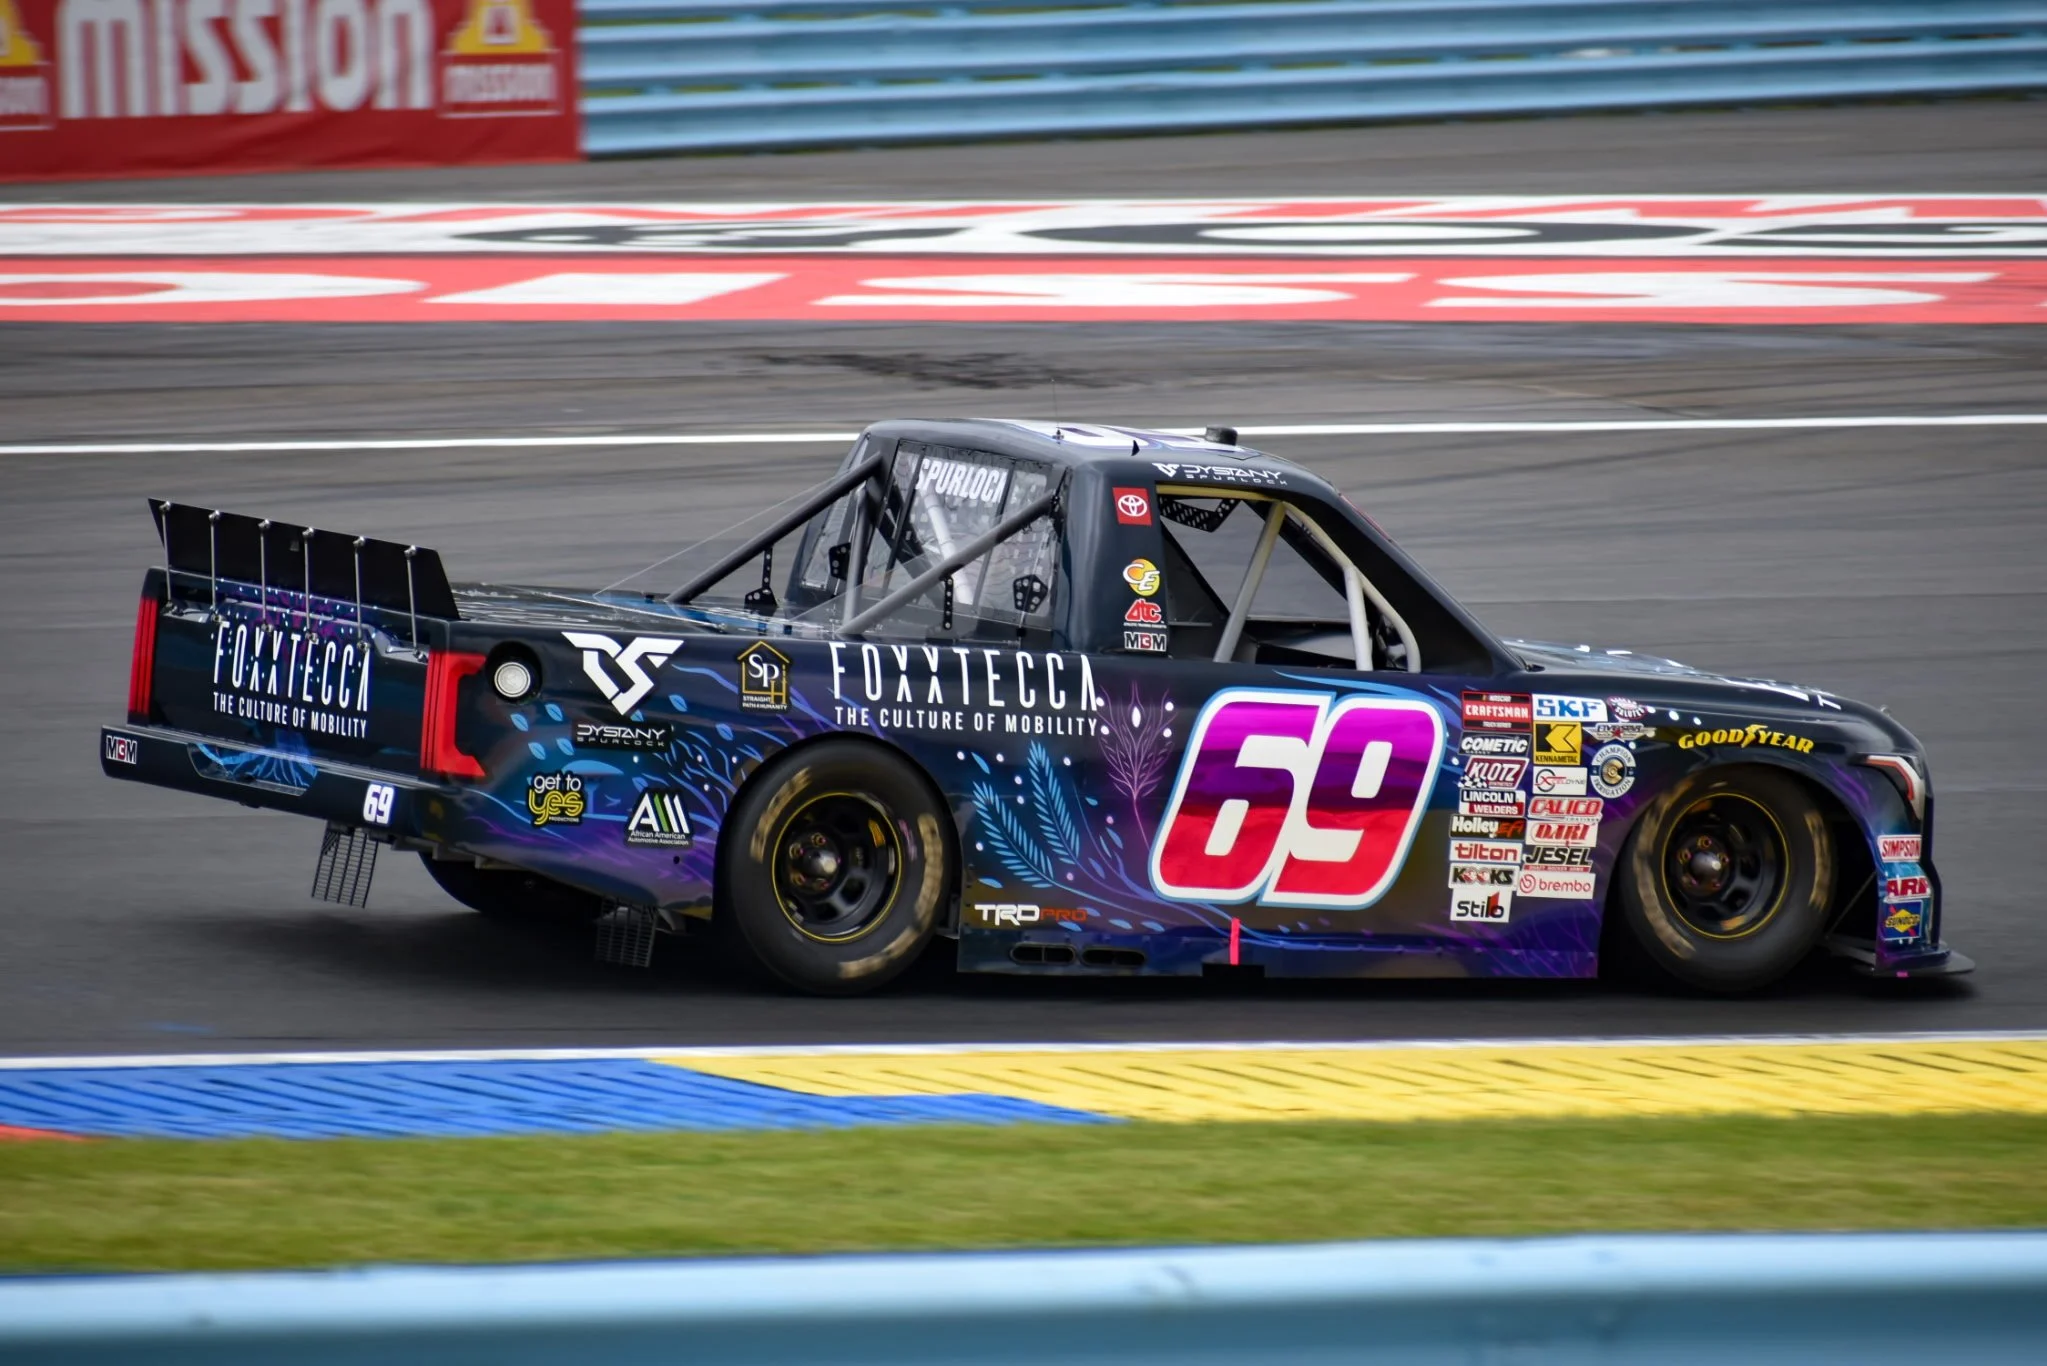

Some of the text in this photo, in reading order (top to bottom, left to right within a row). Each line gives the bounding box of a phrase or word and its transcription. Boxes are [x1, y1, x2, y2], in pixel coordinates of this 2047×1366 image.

[1181, 464, 1281, 479] DYSTANY
[213, 620, 372, 712] FOXXTECCA
[829, 641, 1097, 711] FOXXTECCA
[213, 691, 367, 739] THE CULTURE OF MOBILITY
[1465, 704, 1529, 719] CRAFTSMAN
[1536, 698, 1599, 717] SKF
[834, 706, 1097, 736] THE CULTURE OF MOBILITY
[577, 723, 665, 740] DYSTANY
[1678, 724, 1815, 754] GOODYEAR
[577, 737, 665, 747] SPURLOCK
[1461, 736, 1528, 753] COMETIC
[1535, 755, 1578, 763] KENNAMETAL
[1468, 762, 1521, 782] KLOTZ
[533, 772, 582, 794] get to
[363, 783, 394, 825] 69
[1148, 686, 1446, 910] 69
[1463, 790, 1514, 803] LINCOLN
[528, 788, 584, 825] yes
[1473, 804, 1518, 815] WELDERS
[1531, 798, 1602, 815] CALICO
[1451, 815, 1499, 838] Holley
[1454, 843, 1518, 861] tilton
[1525, 846, 1592, 865] JESEL
[1882, 839, 1921, 858] SIMPSON
[1453, 866, 1514, 885] KOOKS
[1539, 879, 1592, 892] brembo
[1456, 891, 1504, 918] Stilo
[974, 903, 1040, 926] TRD
